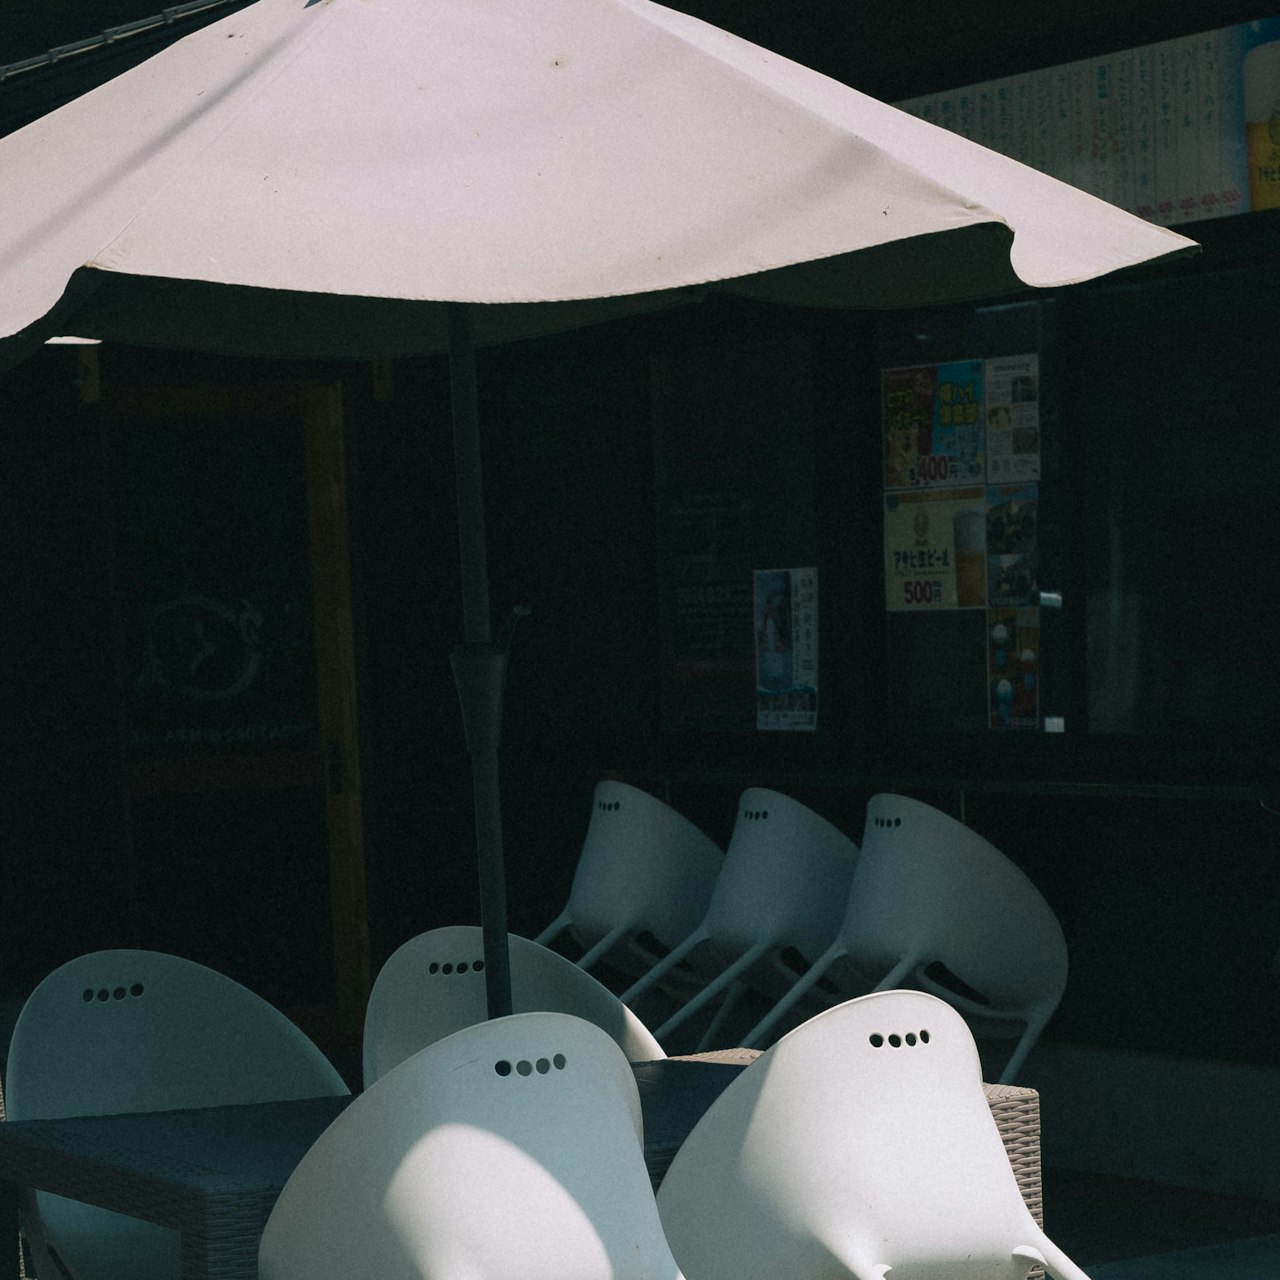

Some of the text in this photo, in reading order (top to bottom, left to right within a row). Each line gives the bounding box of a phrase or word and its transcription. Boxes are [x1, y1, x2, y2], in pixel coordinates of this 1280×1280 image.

[917, 456, 948, 480] 400
[893, 548, 951, 570] アサヒ生ビール
[904, 580, 933, 604] 500
